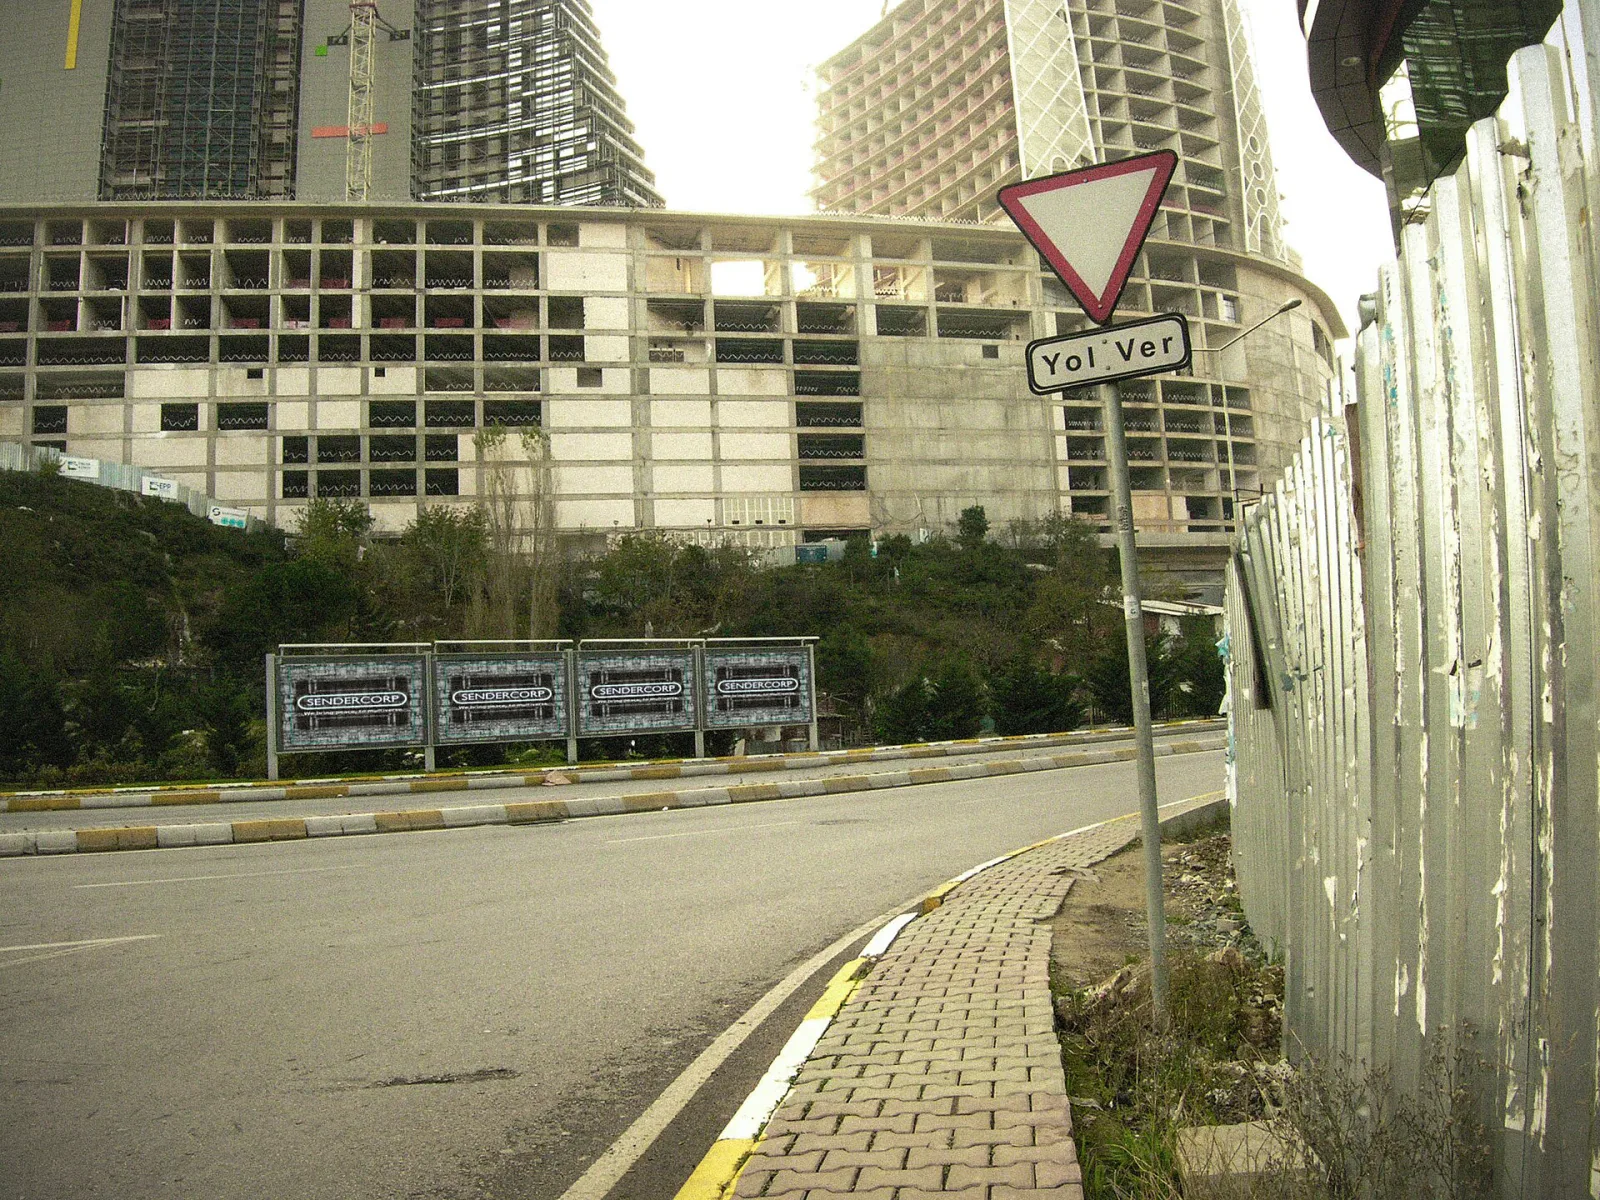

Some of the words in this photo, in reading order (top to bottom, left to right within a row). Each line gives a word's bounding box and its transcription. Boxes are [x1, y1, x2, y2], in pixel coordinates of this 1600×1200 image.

[1041, 346, 1095, 376] Yol
[1115, 336, 1173, 362] Ver
[600, 684, 675, 696] SENDERCORP
[724, 680, 793, 690] SENDERCORP
[307, 694, 400, 706] SENDERCORP
[461, 690, 545, 701] SENDERCORP
